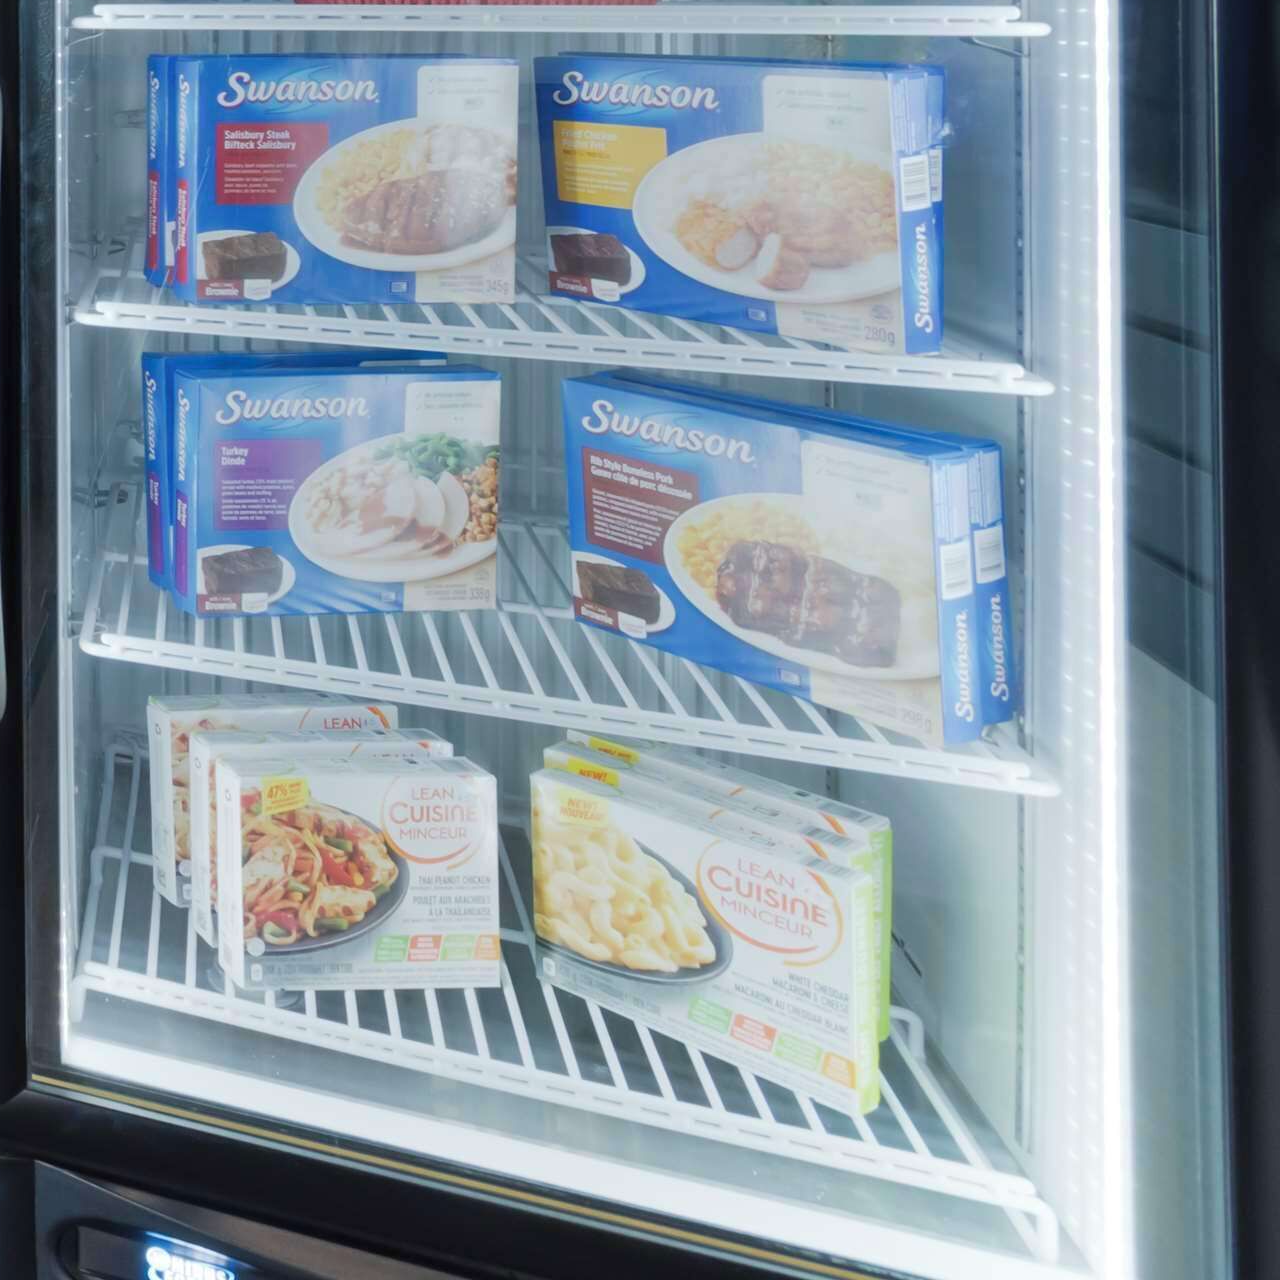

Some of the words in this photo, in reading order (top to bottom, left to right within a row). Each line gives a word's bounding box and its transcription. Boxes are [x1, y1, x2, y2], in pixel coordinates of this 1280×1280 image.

[218, 71, 377, 108] Swanson
[553, 70, 720, 110] Swanson
[224, 130, 265, 142] Salisbury
[266, 129, 291, 140] Steak
[224, 140, 256, 150] Bifteck
[257, 140, 297, 151] Salisbury
[556, 279, 589, 294] Brownie
[914, 222, 935, 333] Swanson
[216, 389, 370, 425] Swanson
[581, 399, 756, 464] Swanson
[222, 446, 249, 457] Turkey
[222, 456, 246, 466] Dinde
[590, 455, 603, 466] Rib
[603, 457, 622, 472] Style
[622, 462, 655, 481] Boneless
[655, 471, 674, 485] Pork
[990, 592, 1009, 701] Swanson
[953, 610, 975, 722] Swanson
[324, 716, 362, 730] LEAN
[410, 786, 454, 801] LEAN
[388, 800, 478, 825] CUISINE
[398, 827, 468, 841] MINCEUR
[737, 857, 797, 889] LEAN
[707, 865, 829, 928] CUISINE
[719, 895, 814, 939] MINCEUR
